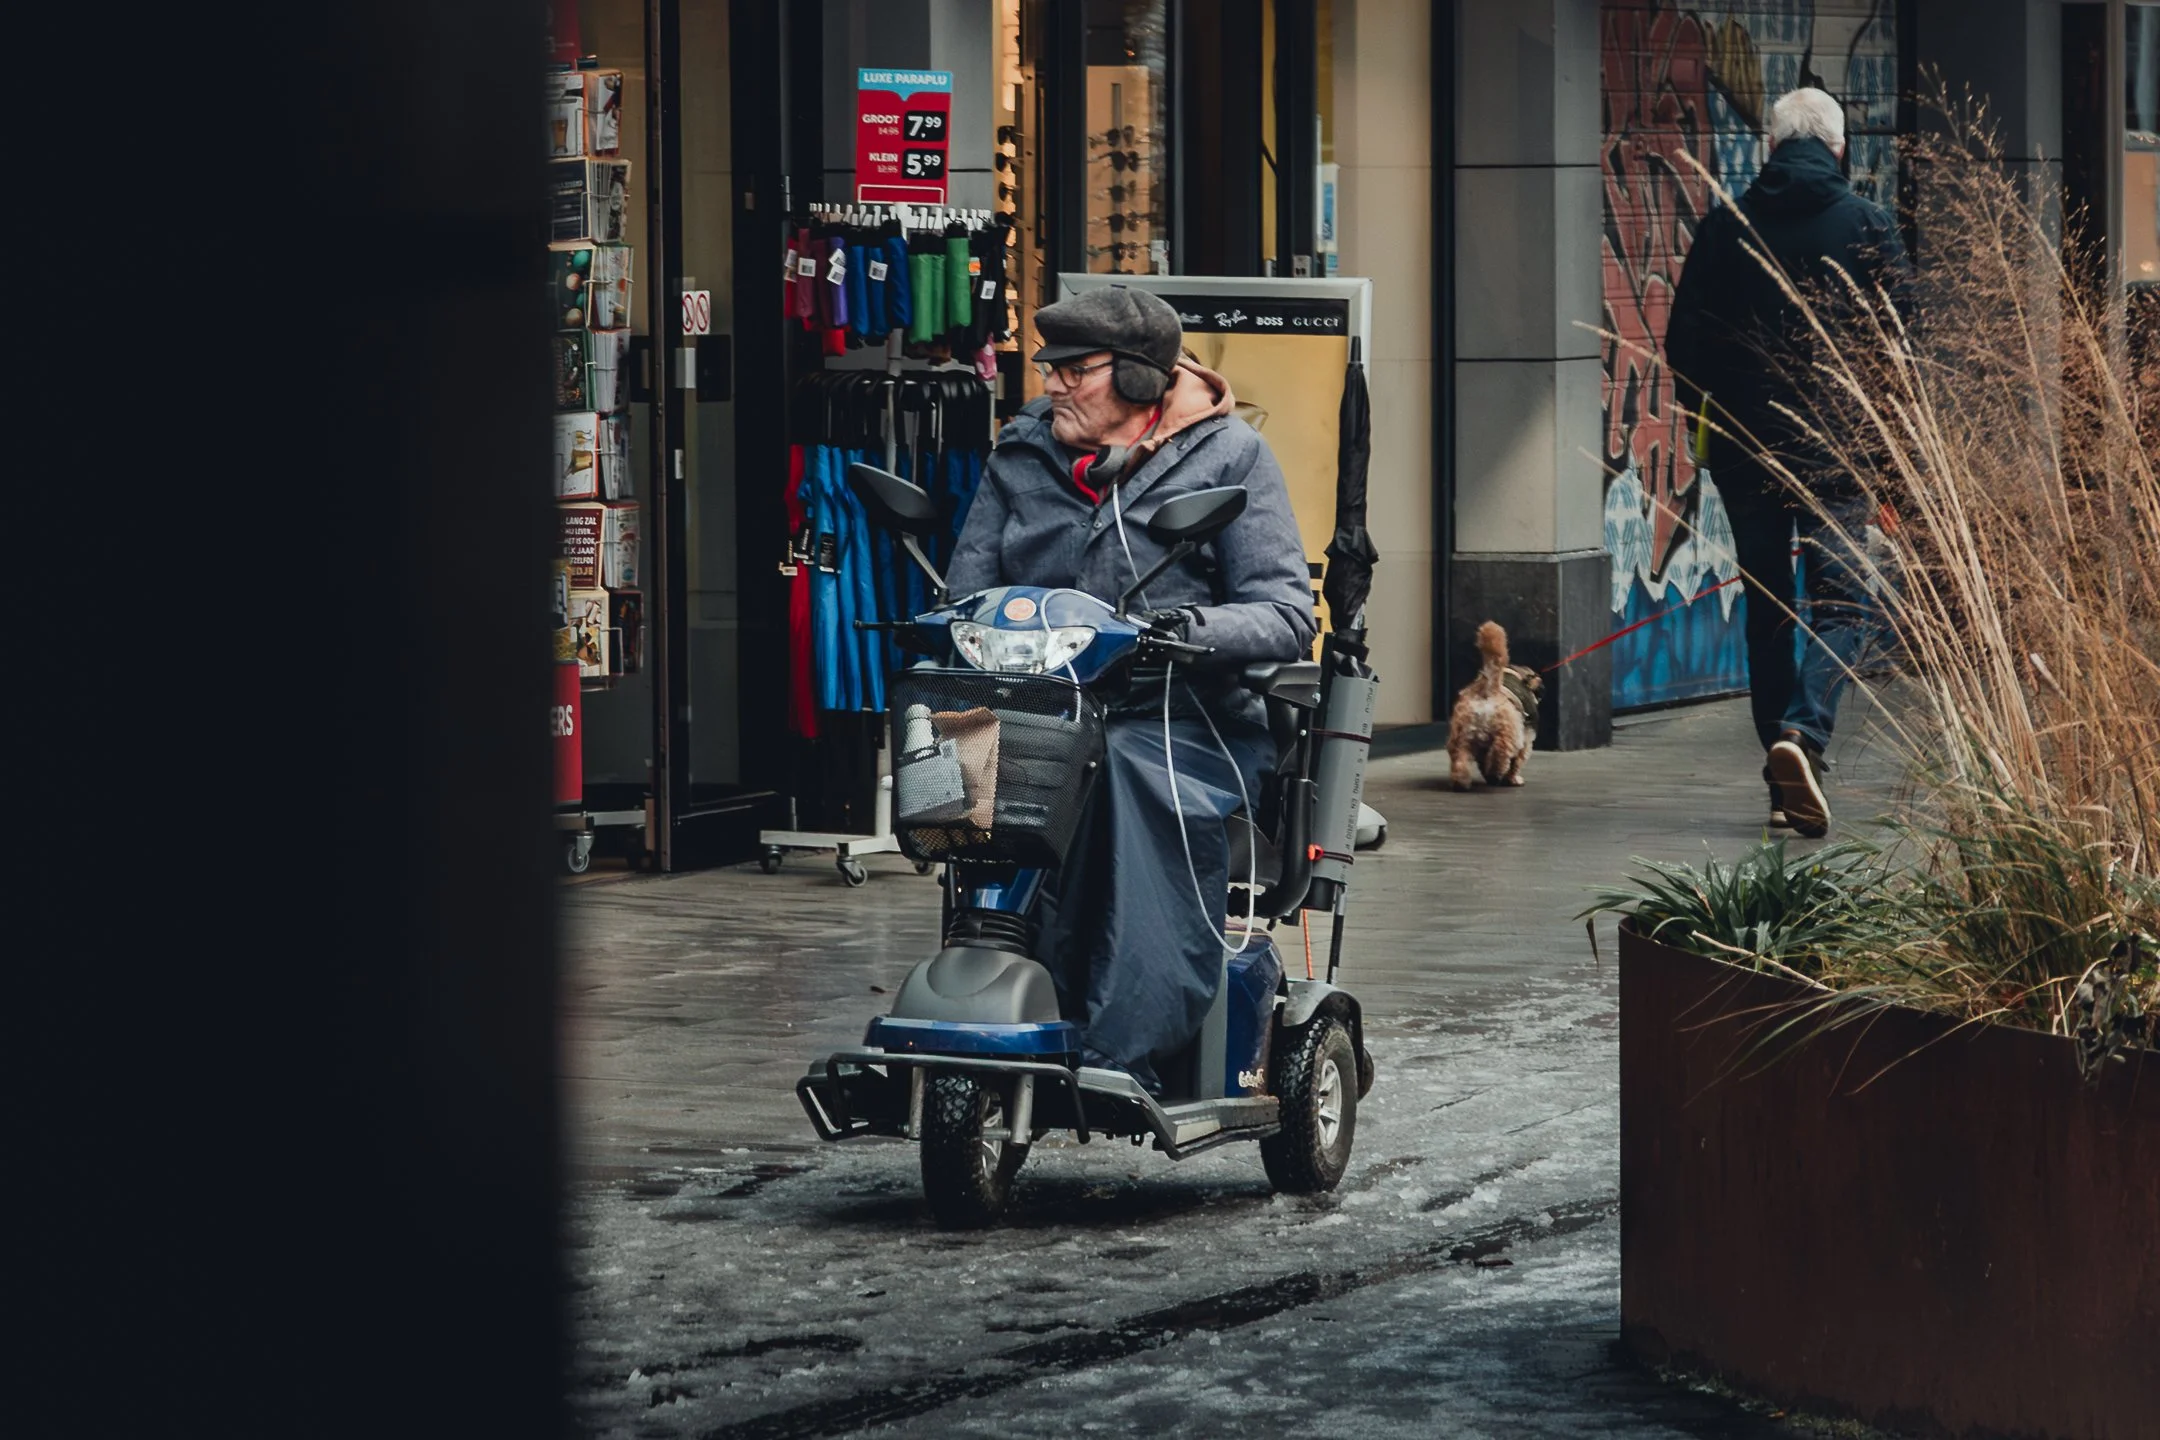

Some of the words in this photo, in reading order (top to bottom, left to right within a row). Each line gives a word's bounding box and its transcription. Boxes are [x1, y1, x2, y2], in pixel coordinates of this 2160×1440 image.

[863, 72, 893, 84] LUXE
[895, 73, 948, 86] PARAPLU
[861, 114, 900, 125] GROOT
[868, 152, 898, 163] KLEIN
[1255, 316, 1284, 327] BOSS
[1292, 316, 1339, 328] GUCCI
[566, 517, 584, 525] LANG
[584, 517, 597, 525] ZAL
